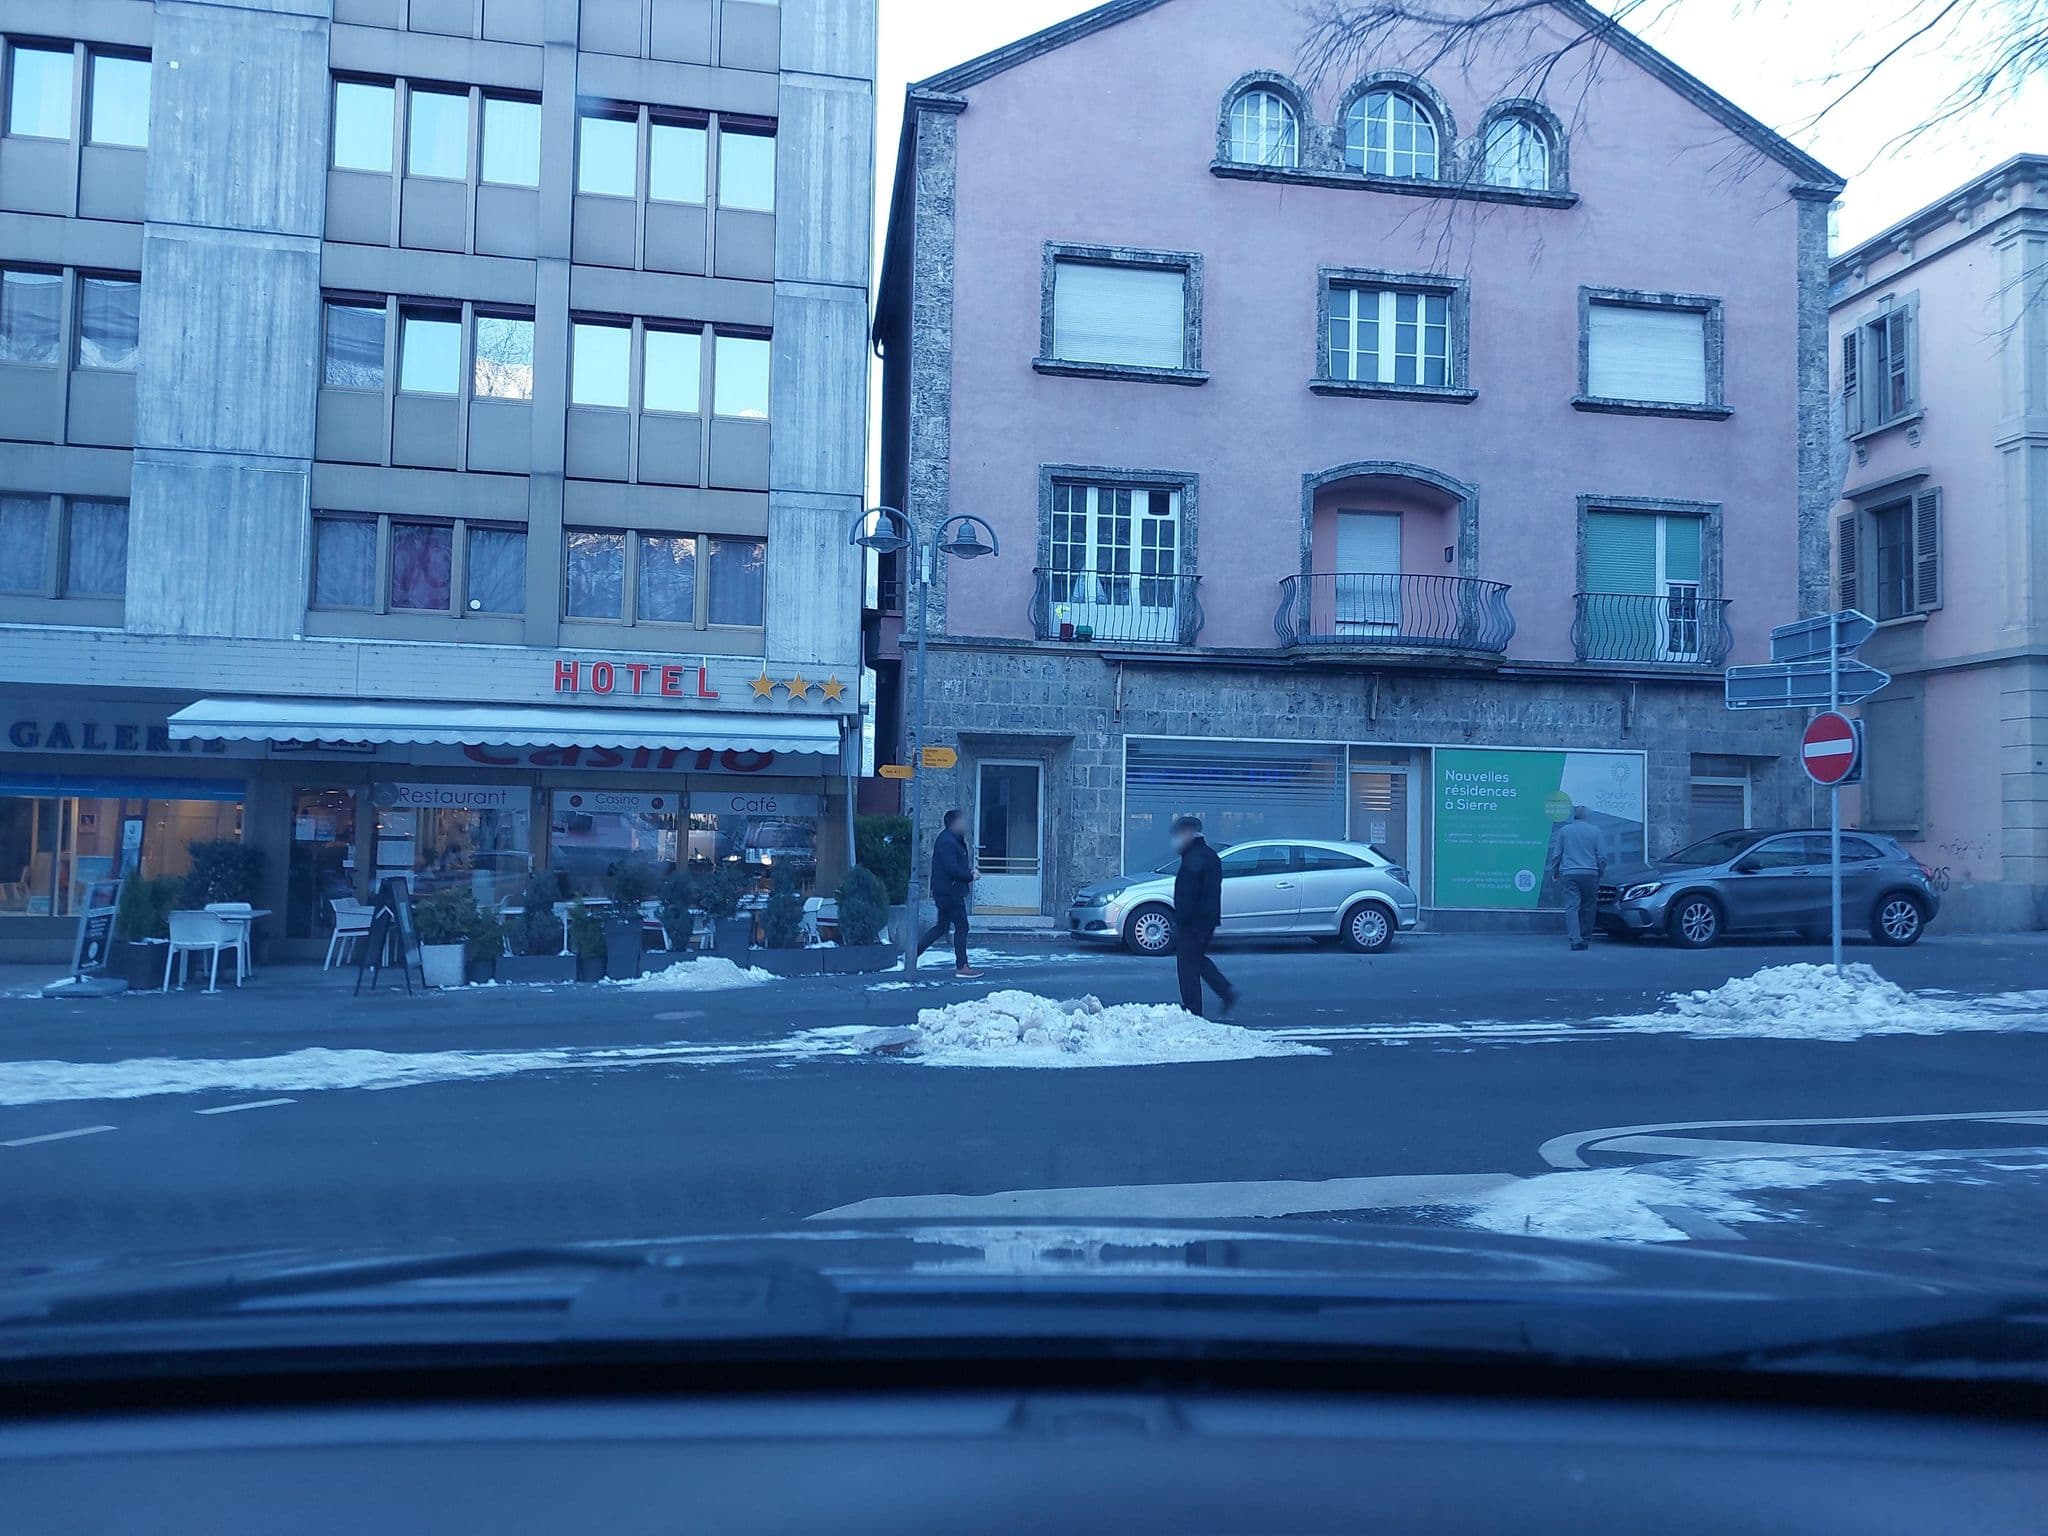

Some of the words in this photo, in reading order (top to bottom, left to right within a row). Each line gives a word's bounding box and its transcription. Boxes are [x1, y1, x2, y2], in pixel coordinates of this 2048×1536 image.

[553, 660, 719, 700] HOTEL
[1445, 769, 1510, 783] Nouvelles
[399, 787, 506, 805] Restaurant
[1445, 784, 1517, 797] résidences
[595, 793, 639, 805] Casino
[731, 796, 777, 812] Café
[1445, 798, 1454, 810] à
[1457, 798, 1498, 811] Sierre
